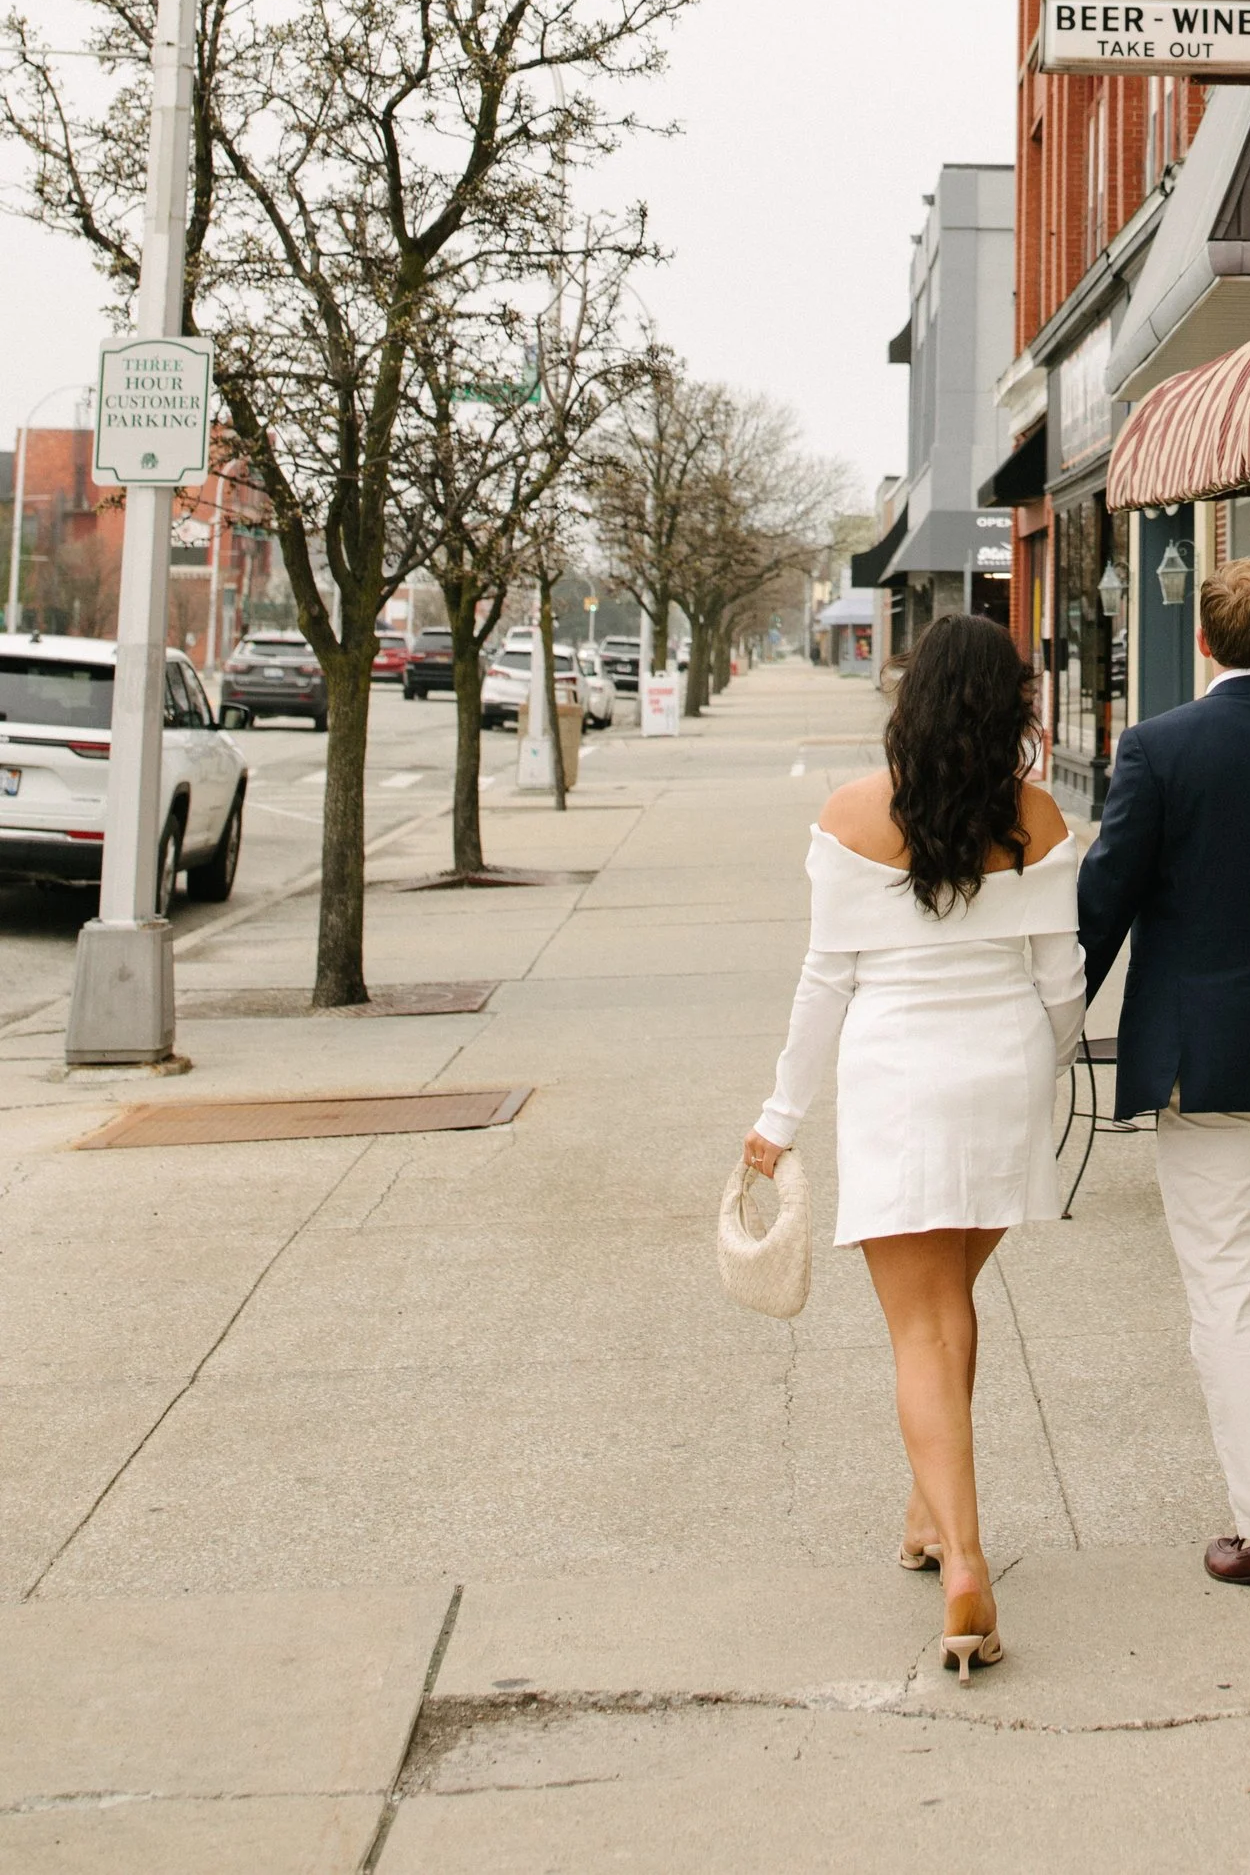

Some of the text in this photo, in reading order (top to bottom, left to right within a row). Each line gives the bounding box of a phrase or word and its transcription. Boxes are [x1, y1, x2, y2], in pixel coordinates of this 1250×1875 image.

[1056, 5, 1144, 33] BEER
[1097, 40, 1214, 59] TAKE OUT
[123, 357, 183, 372] THREE
[125, 376, 183, 391] HOUR
[105, 395, 200, 410] CUSTOMER
[106, 413, 198, 428] PARKING
